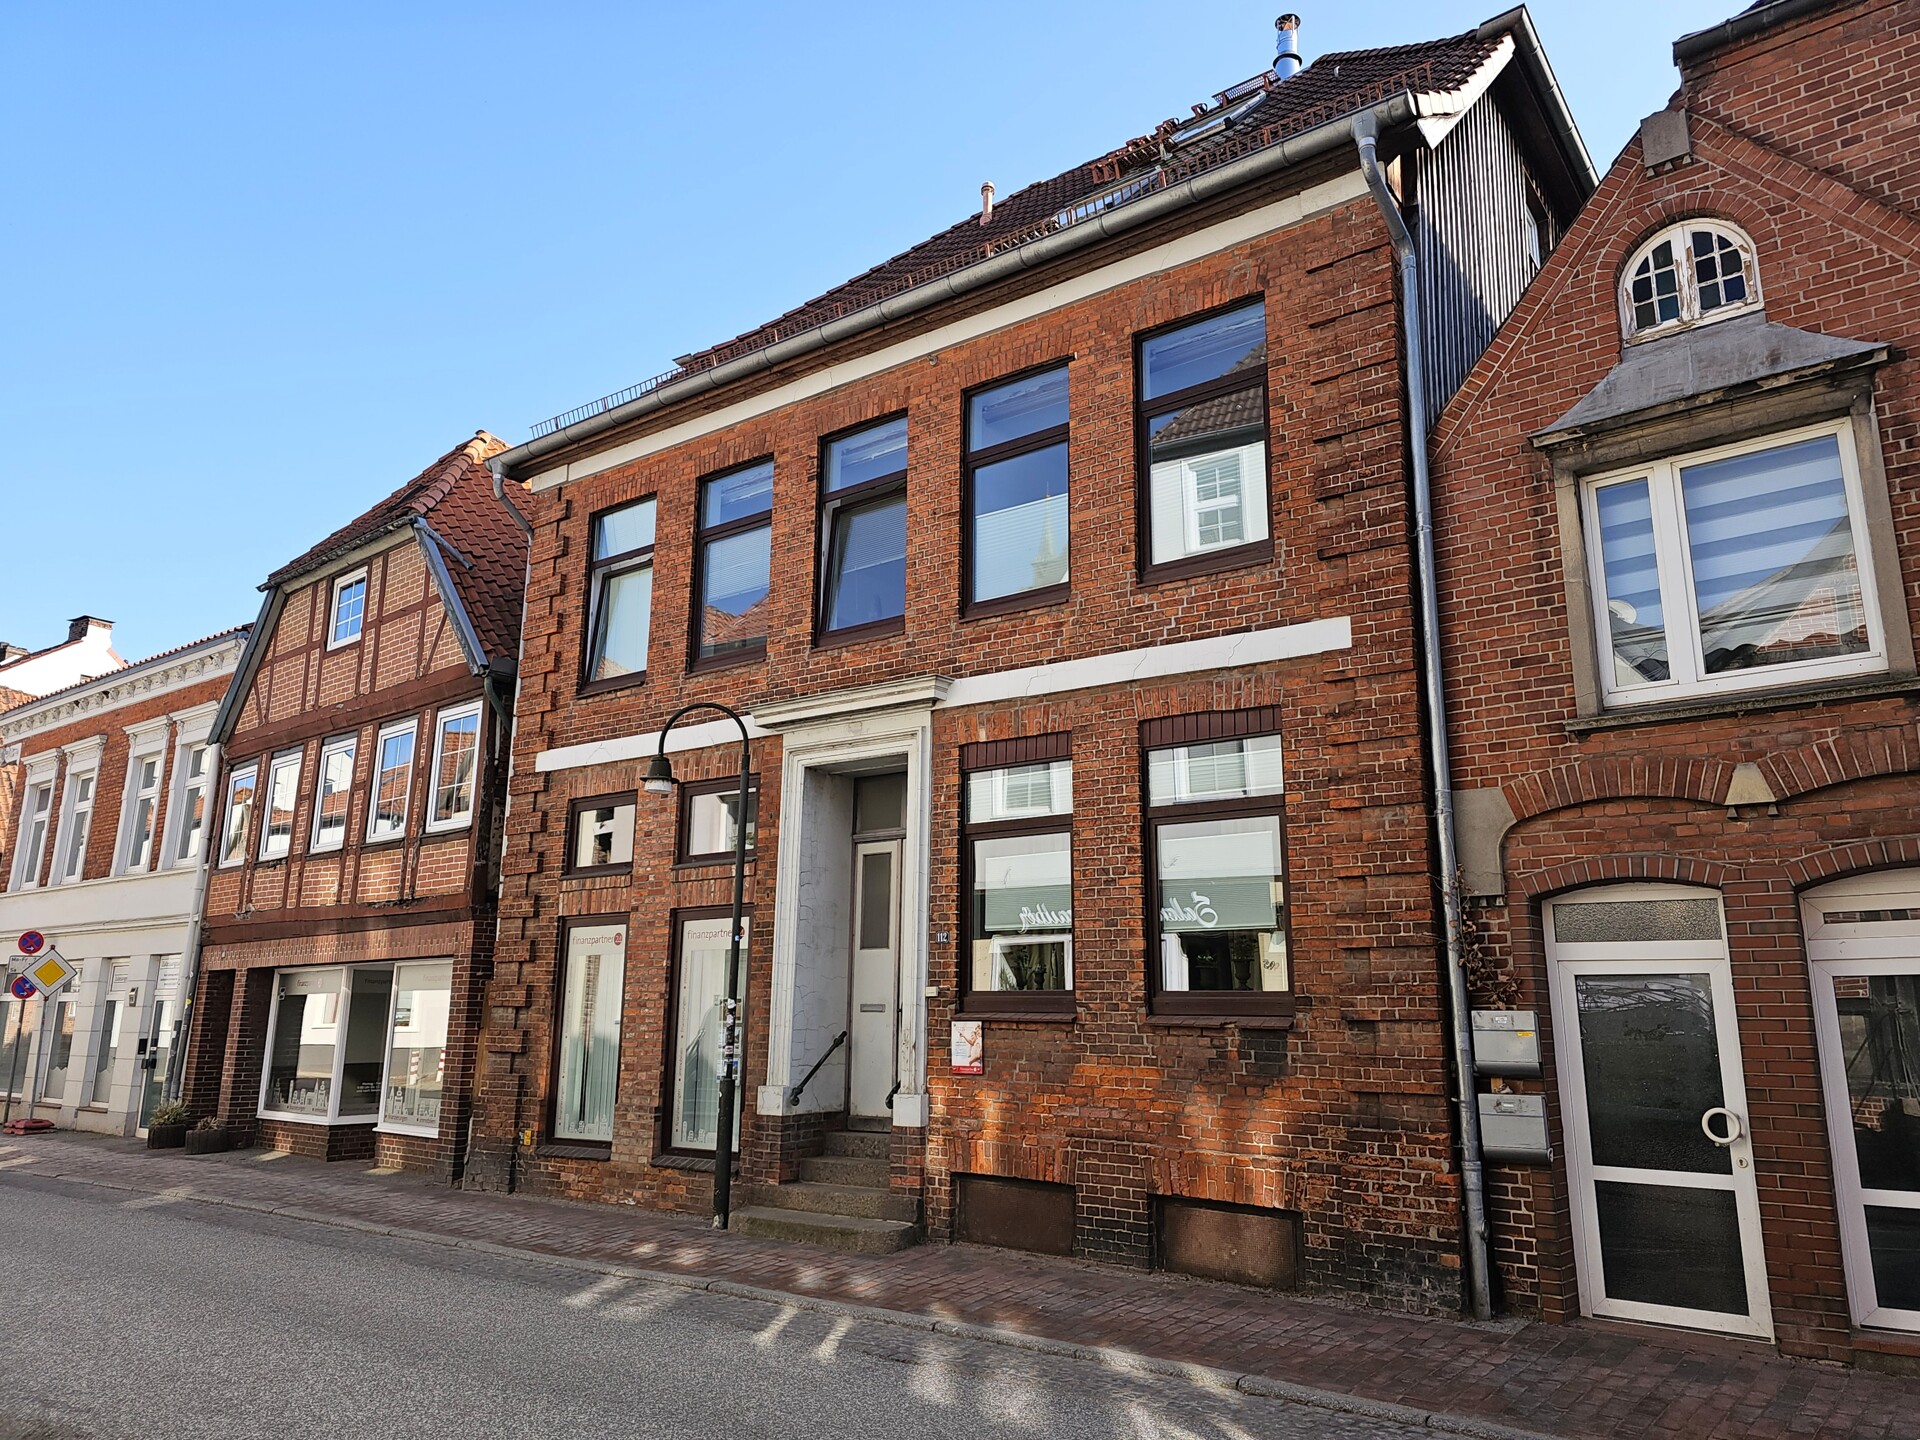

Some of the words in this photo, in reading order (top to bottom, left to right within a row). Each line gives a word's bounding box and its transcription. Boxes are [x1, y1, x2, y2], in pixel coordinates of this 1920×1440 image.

[687, 928, 733, 941] finanzpartne
[937, 932, 948, 942] 112
[572, 935, 614, 946] finanzpartner
